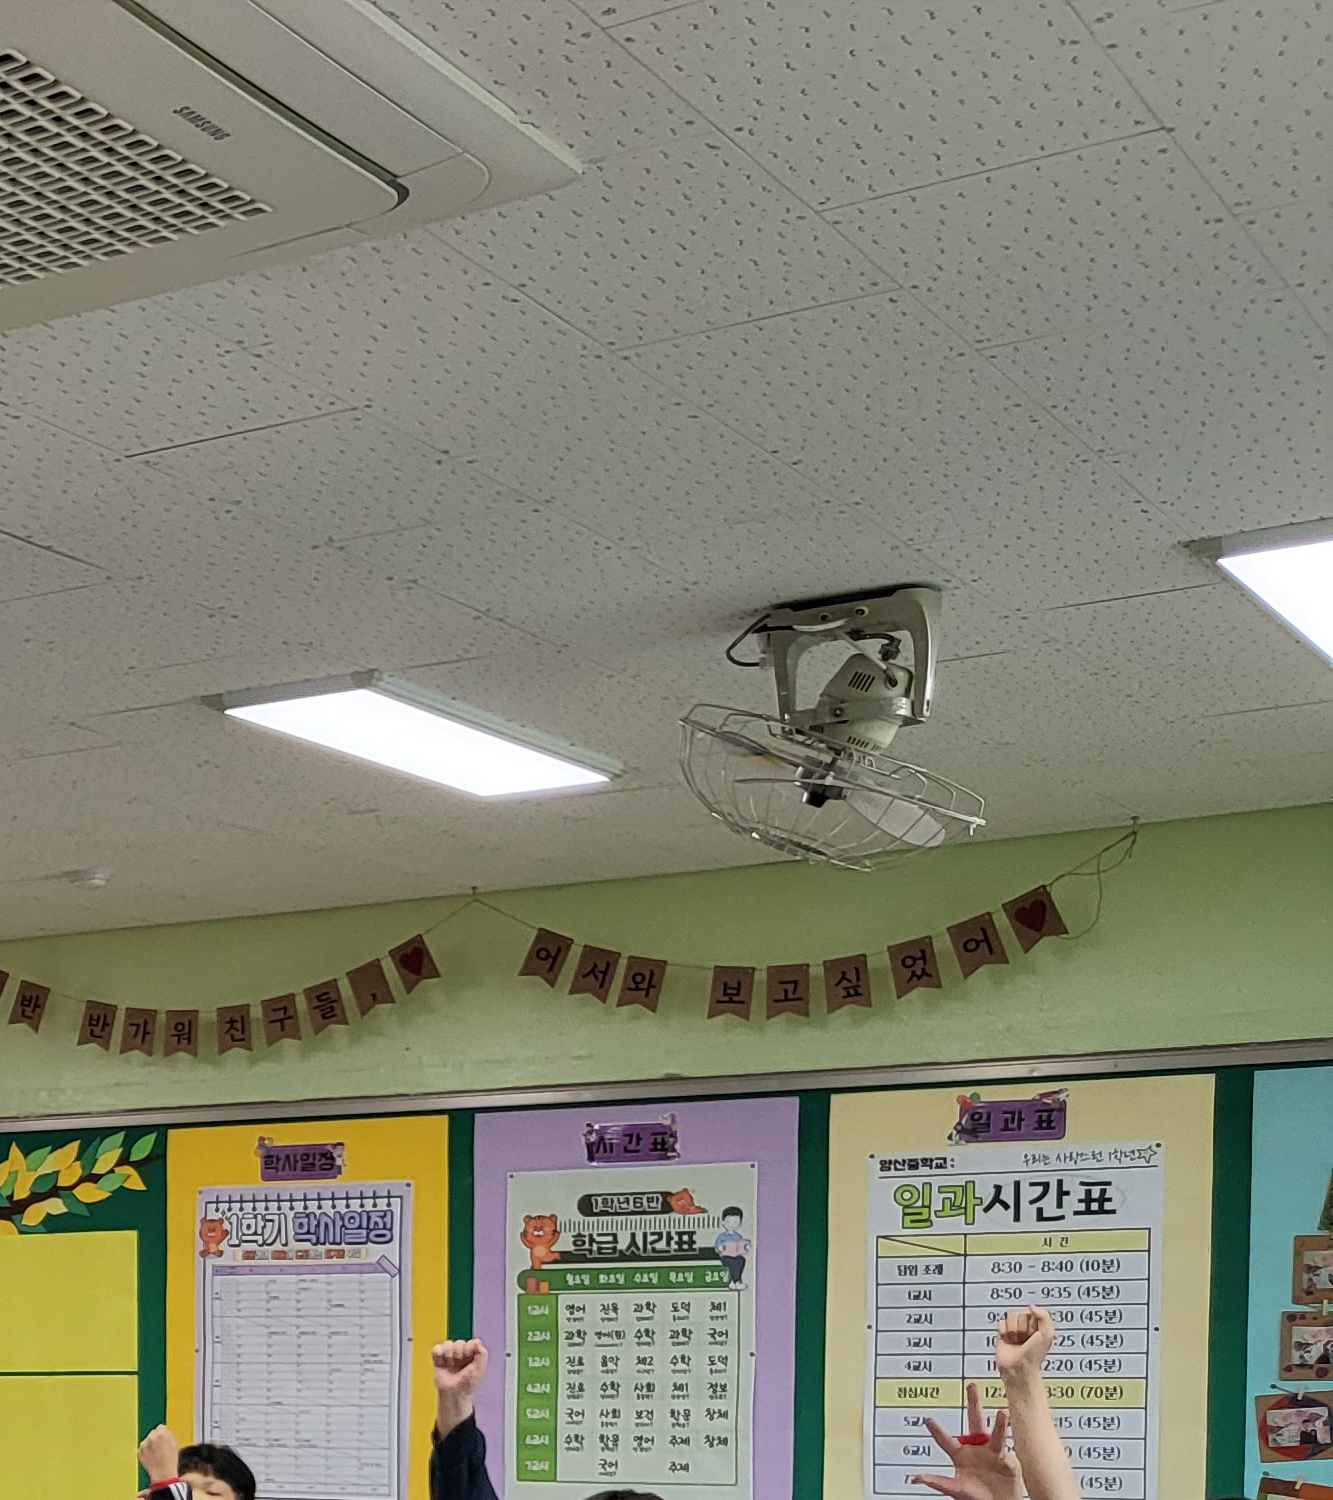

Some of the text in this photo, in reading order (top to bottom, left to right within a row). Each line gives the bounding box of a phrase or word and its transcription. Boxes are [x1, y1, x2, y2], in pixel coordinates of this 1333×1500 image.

[173, 105, 232, 142] SAMSUNG
[535, 944, 658, 999] 어서와
[87, 1013, 193, 1046] 반가워
[1022, 1152, 1051, 1167] 우리는
[894, 1178, 1117, 1229] 일과시간표
[228, 1210, 393, 1247] 1학기 학사일정
[571, 1231, 698, 1258] 학급 시간표
[922, 1264, 944, 1276] 조례
[991, 1261, 1023, 1274] 8:30
[1041, 1259, 1074, 1273] 8:40
[1079, 1258, 1121, 1274] (10분)
[990, 1287, 1023, 1300] 8:50
[1041, 1286, 1072, 1299] 9:35
[1077, 1284, 1121, 1300] (45분)
[565, 1303, 586, 1316] 영어
[633, 1301, 657, 1314] 과학
[671, 1301, 691, 1314] 도덕
[905, 1313, 933, 1325] 2교시
[1079, 1310, 1123, 1325] (45분)
[564, 1329, 587, 1342] 과학
[634, 1328, 656, 1341] 수학
[669, 1328, 693, 1341] 과학
[707, 1328, 729, 1341] 국어
[905, 1336, 932, 1348] 3교시
[1080, 1334, 1124, 1349] (45분)
[670, 1355, 692, 1367] 수학
[707, 1355, 728, 1366] 도덕
[904, 1360, 932, 1372] 4교시
[1079, 1358, 1122, 1373] (45분)
[599, 1382, 621, 1394] 수학
[634, 1382, 656, 1394] 사회
[707, 1382, 728, 1394] 정보
[1080, 1385, 1124, 1400] (70분)
[565, 1407, 585, 1420] 국어
[599, 1408, 621, 1419] 사회
[635, 1409, 654, 1420] 보건
[704, 1408, 728, 1421] 창체
[1078, 1415, 1121, 1431] (45분)
[564, 1434, 585, 1446] 수학
[633, 1435, 654, 1447] 영어
[669, 1435, 691, 1447] 주제
[704, 1434, 728, 1448] 창체
[902, 1445, 931, 1457] 6교시
[1078, 1445, 1121, 1461] (45분)
[598, 1459, 618, 1471] 국어
[669, 1462, 690, 1473] 주제
[1080, 1475, 1123, 1492] (45분)
